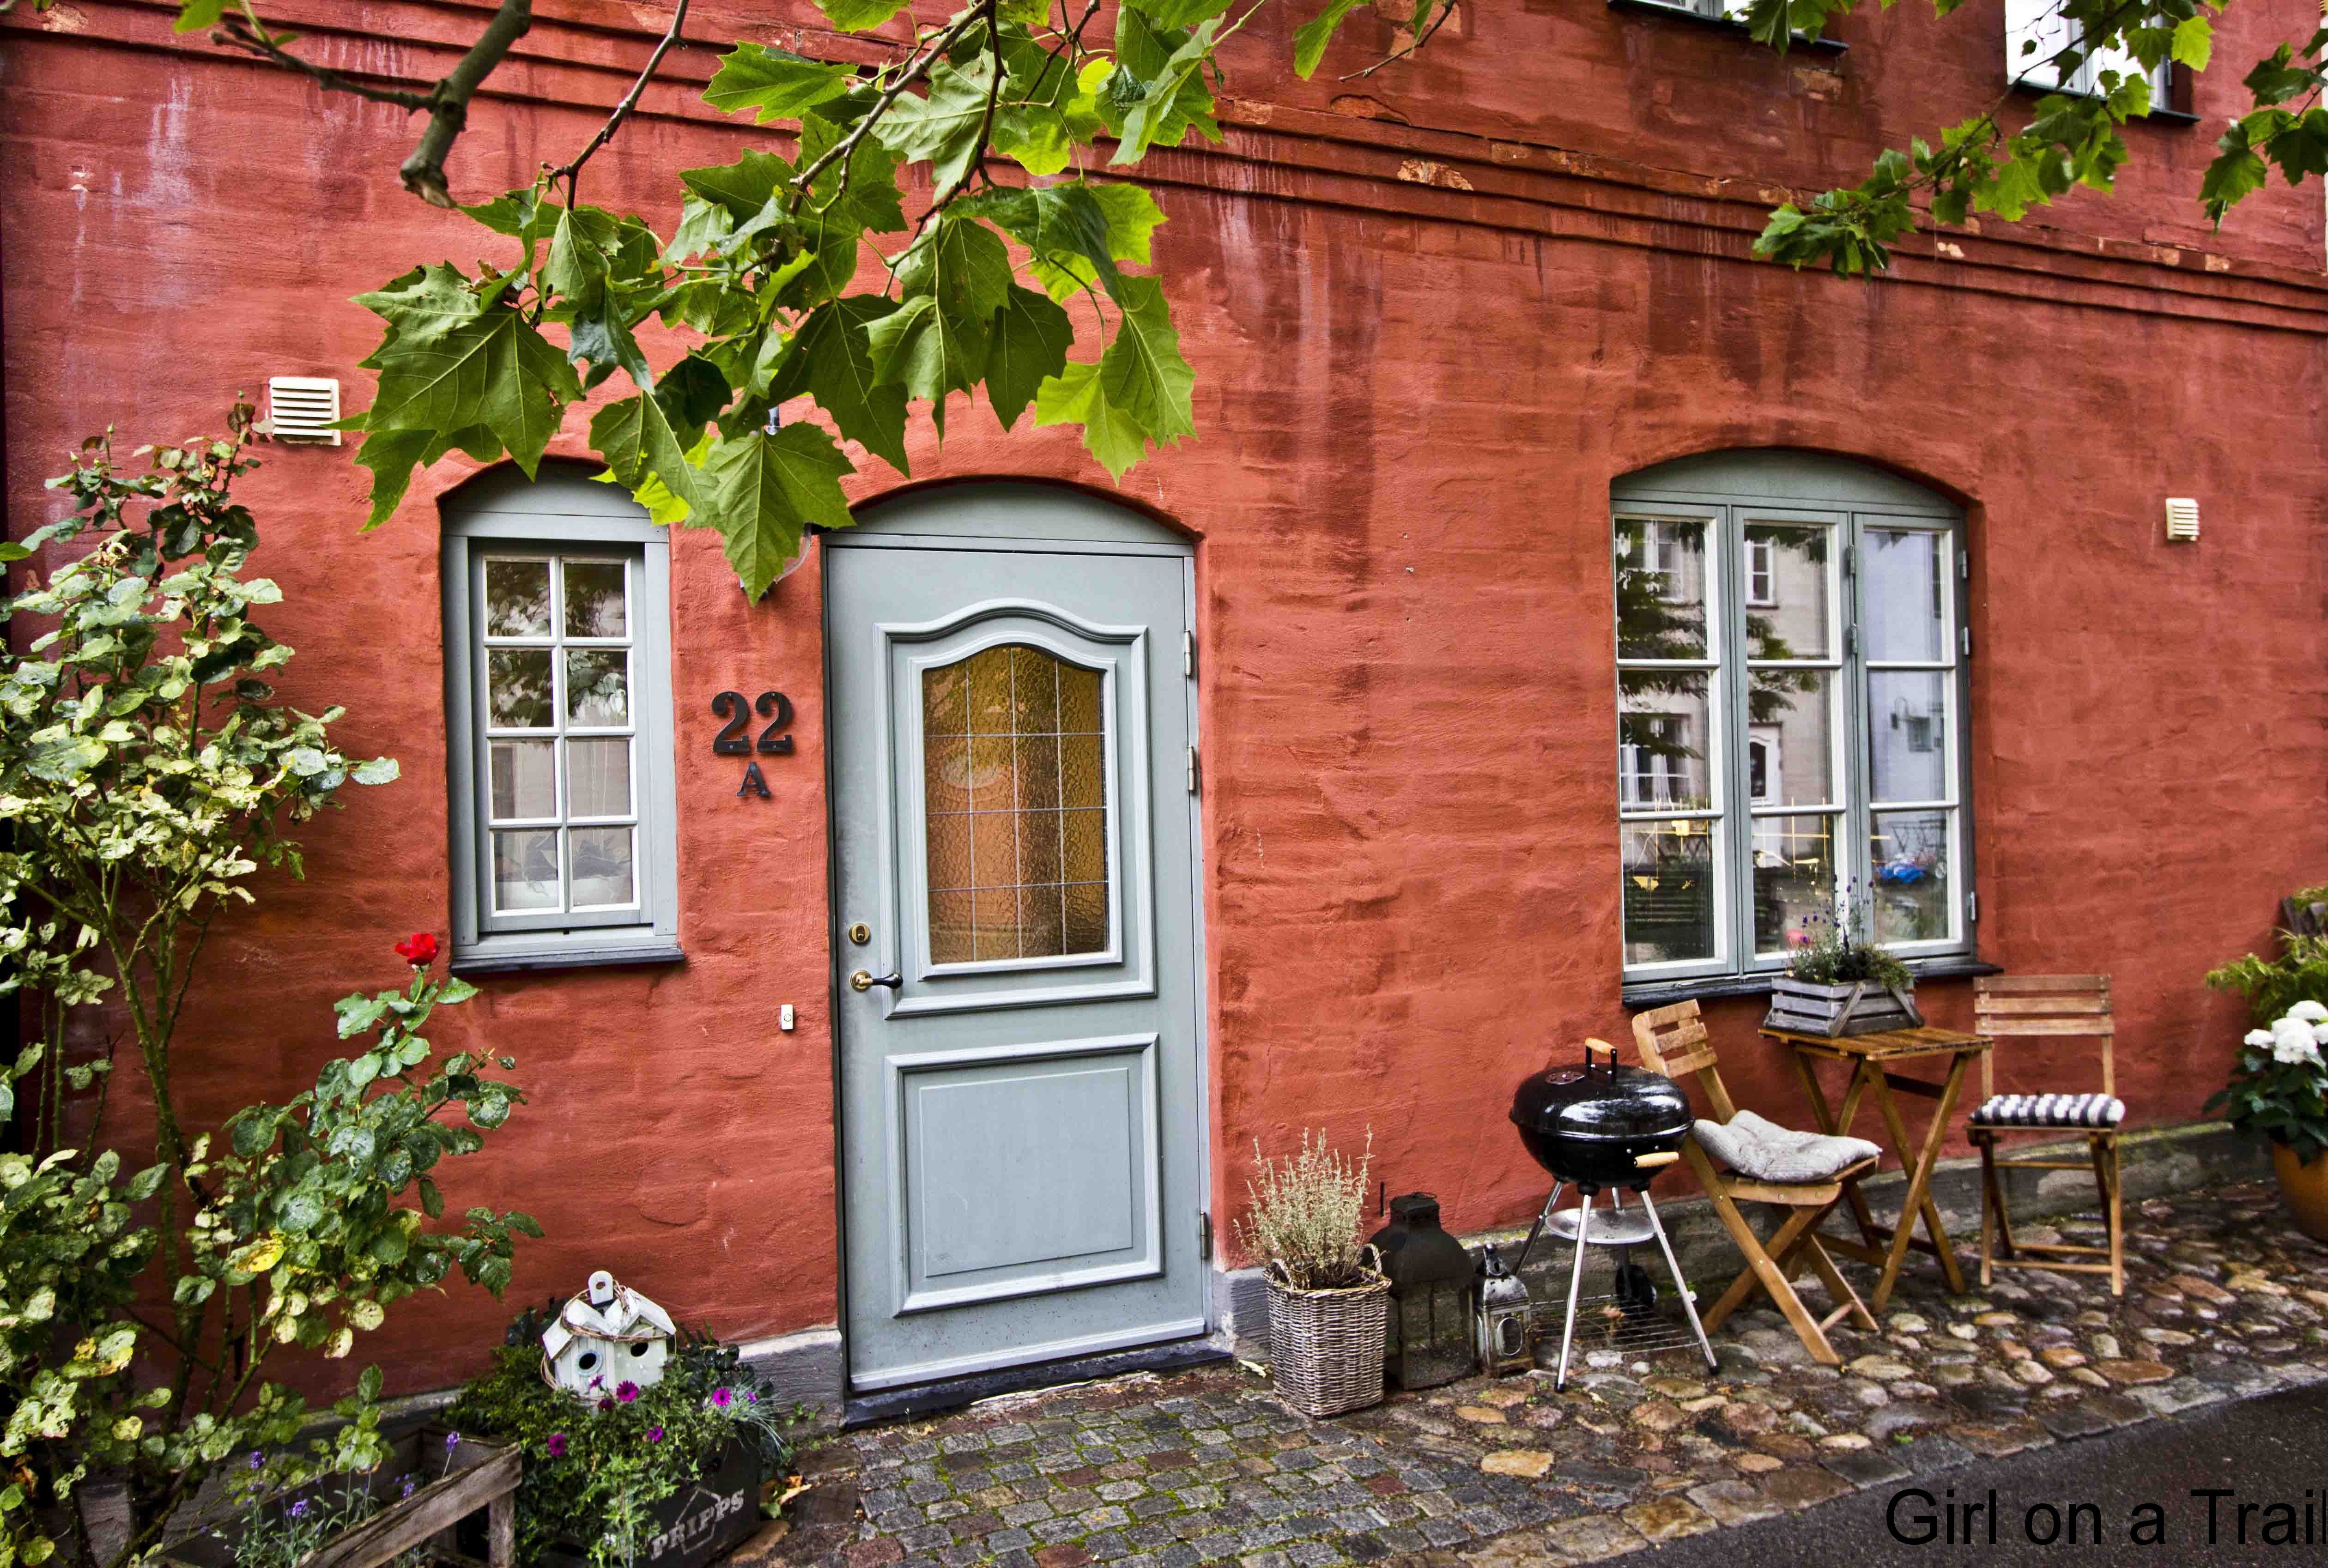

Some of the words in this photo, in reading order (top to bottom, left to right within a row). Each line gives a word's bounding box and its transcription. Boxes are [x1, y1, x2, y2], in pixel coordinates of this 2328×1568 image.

[712, 691, 793, 754] 22
[736, 762, 771, 798] A
[650, 1488, 744, 1561] PRIPPS
